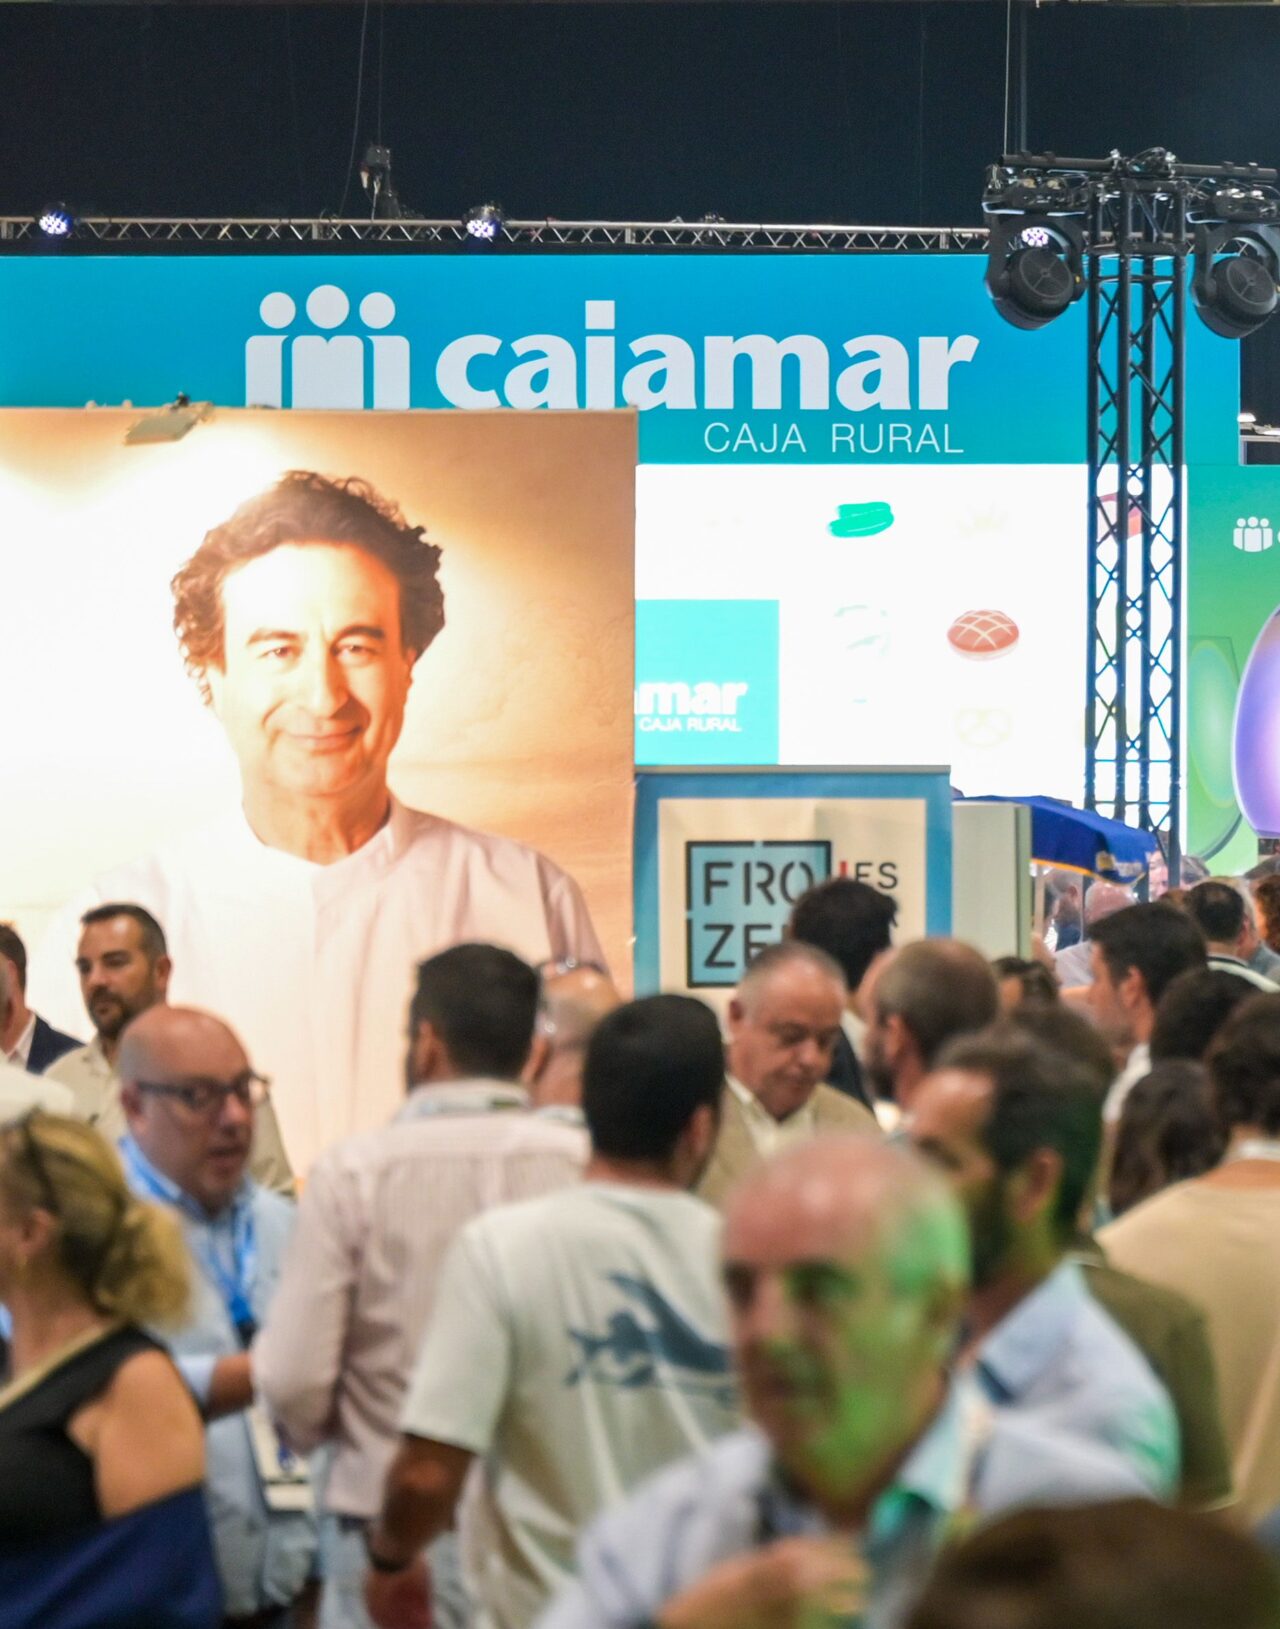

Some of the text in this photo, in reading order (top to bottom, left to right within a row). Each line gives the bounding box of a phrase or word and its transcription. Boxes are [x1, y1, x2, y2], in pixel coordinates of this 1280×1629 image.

[703, 423, 964, 453] CAJA RURAL
[634, 682, 748, 715] mar
[640, 717, 742, 733] CAJA RURAL
[703, 923, 791, 968] ZE
